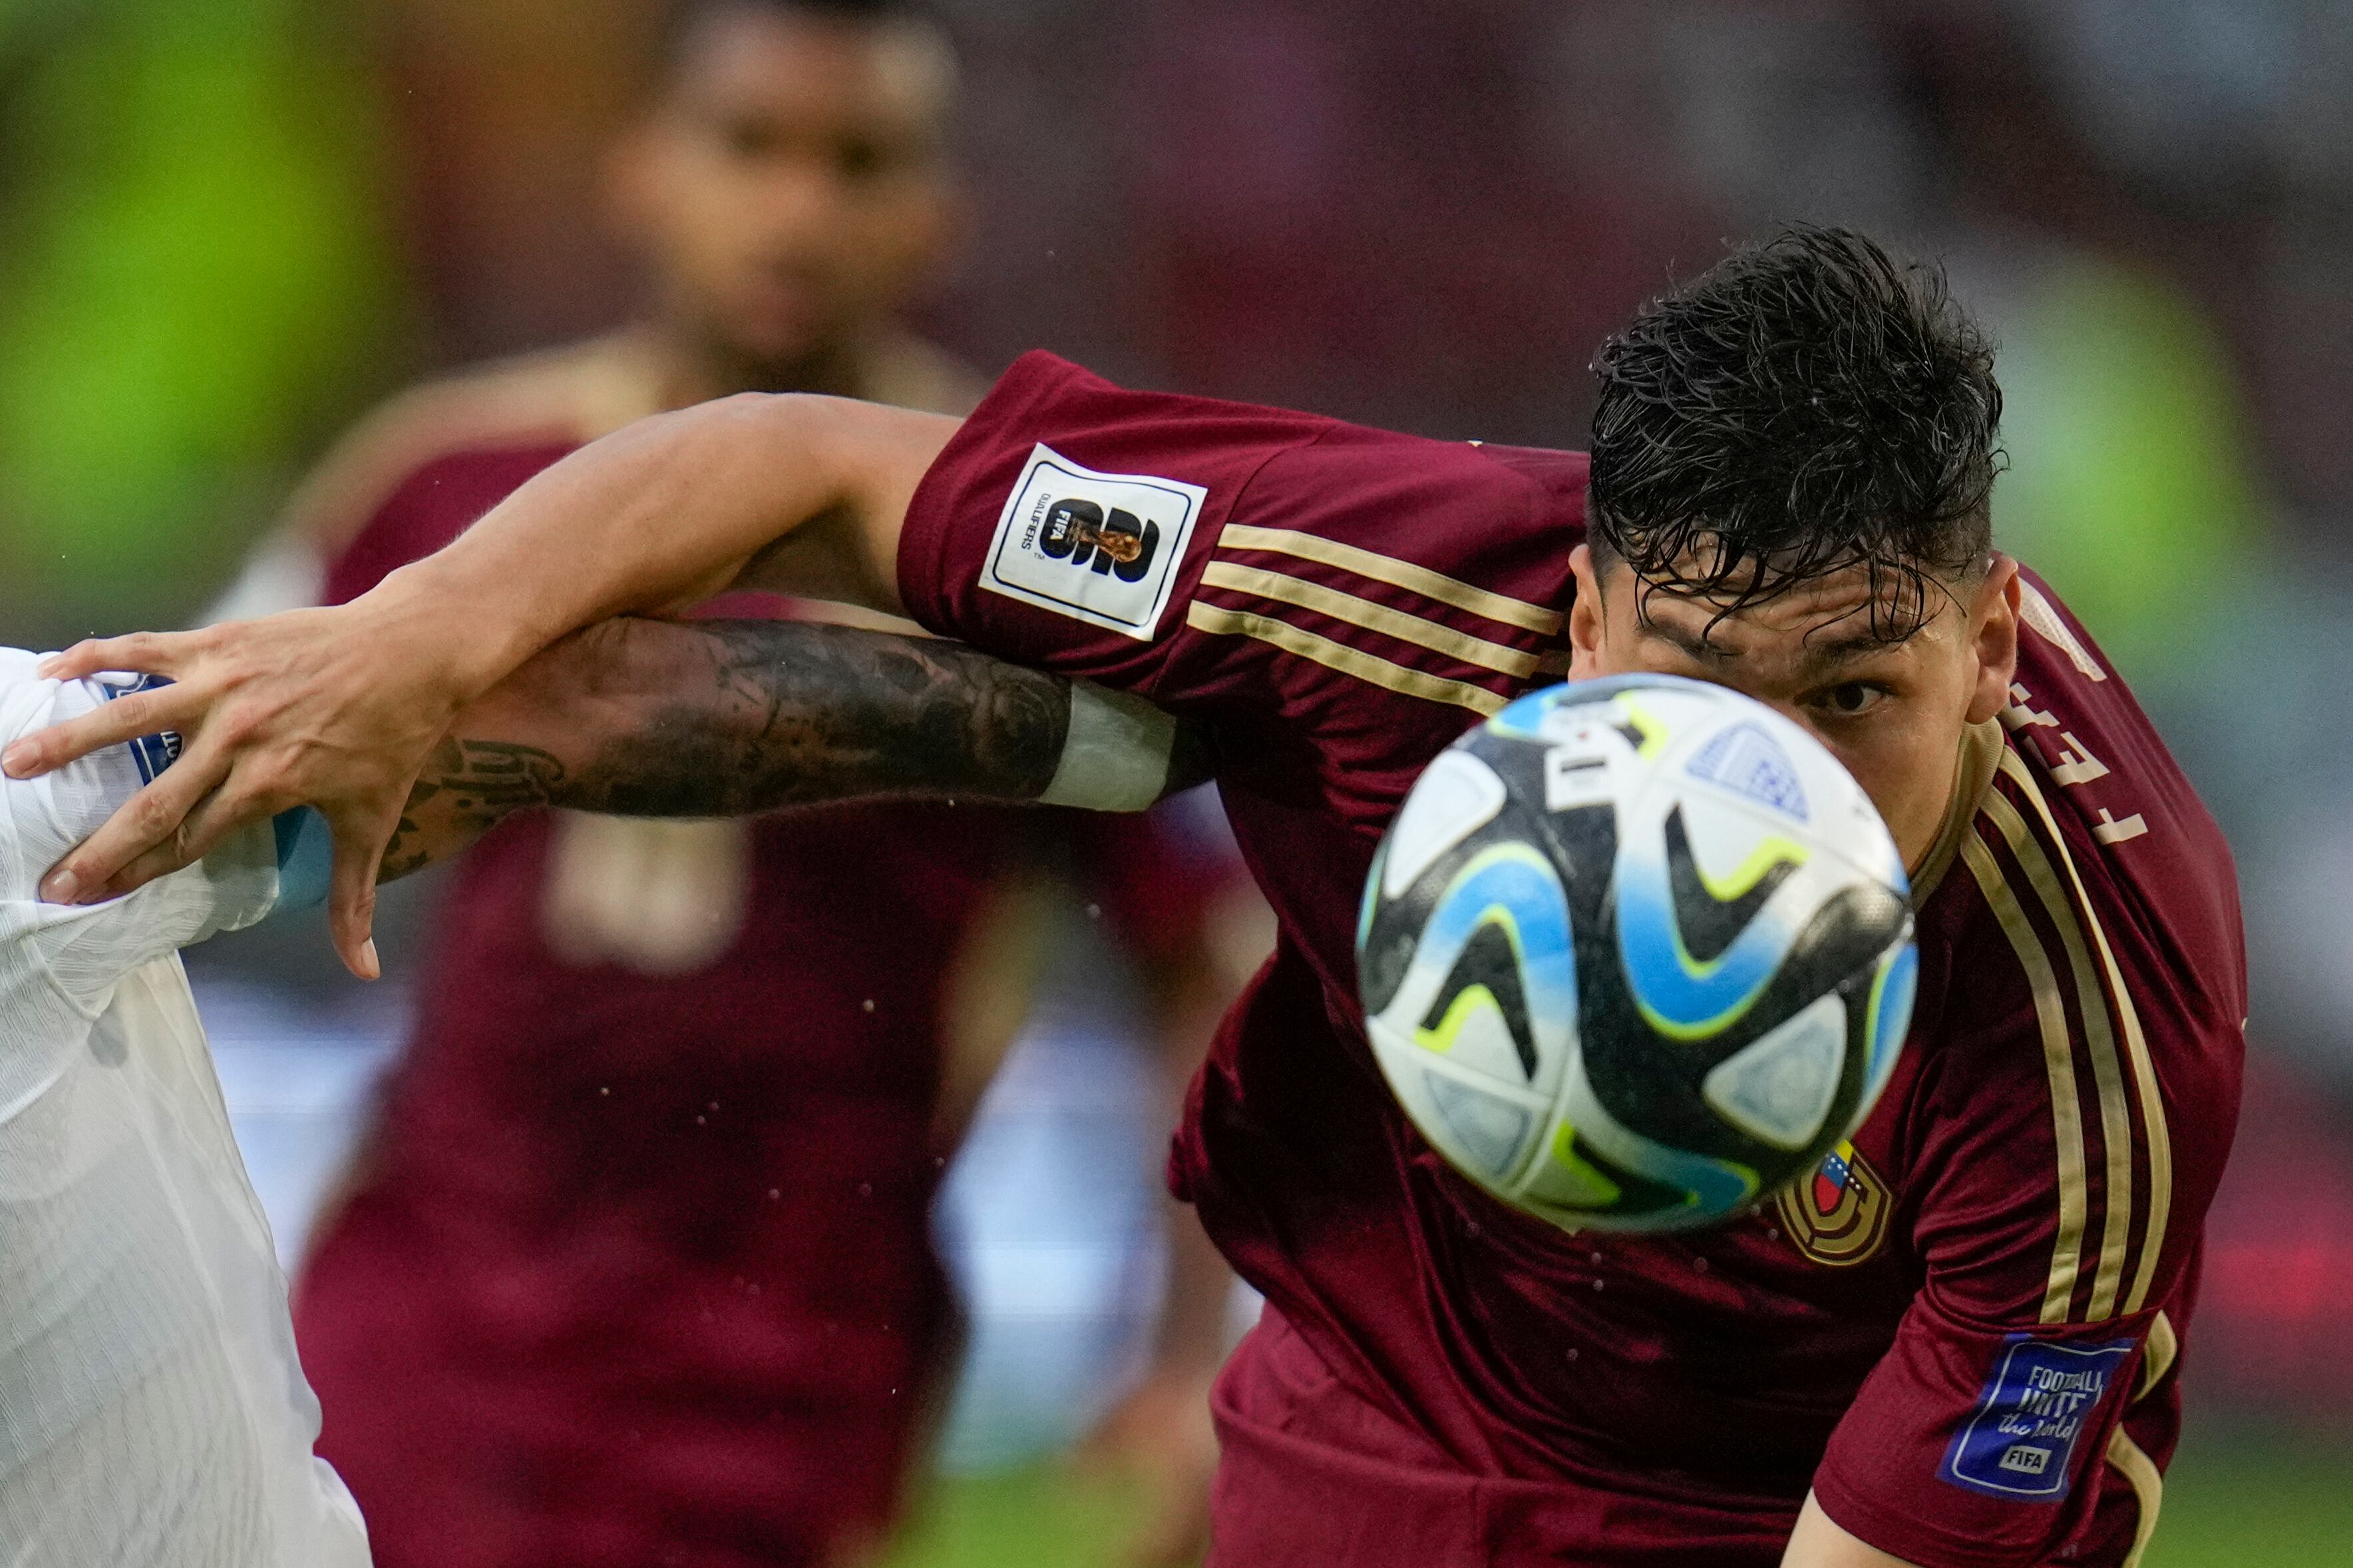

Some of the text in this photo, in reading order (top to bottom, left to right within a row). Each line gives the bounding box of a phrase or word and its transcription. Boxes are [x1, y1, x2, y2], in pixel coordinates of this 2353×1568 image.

[1021, 493, 1051, 550] QUALIFIERS
[1049, 510, 1071, 540] FIFA
[1997, 1412, 2032, 1436] the
[2006, 1450, 2042, 1469] FIFA
